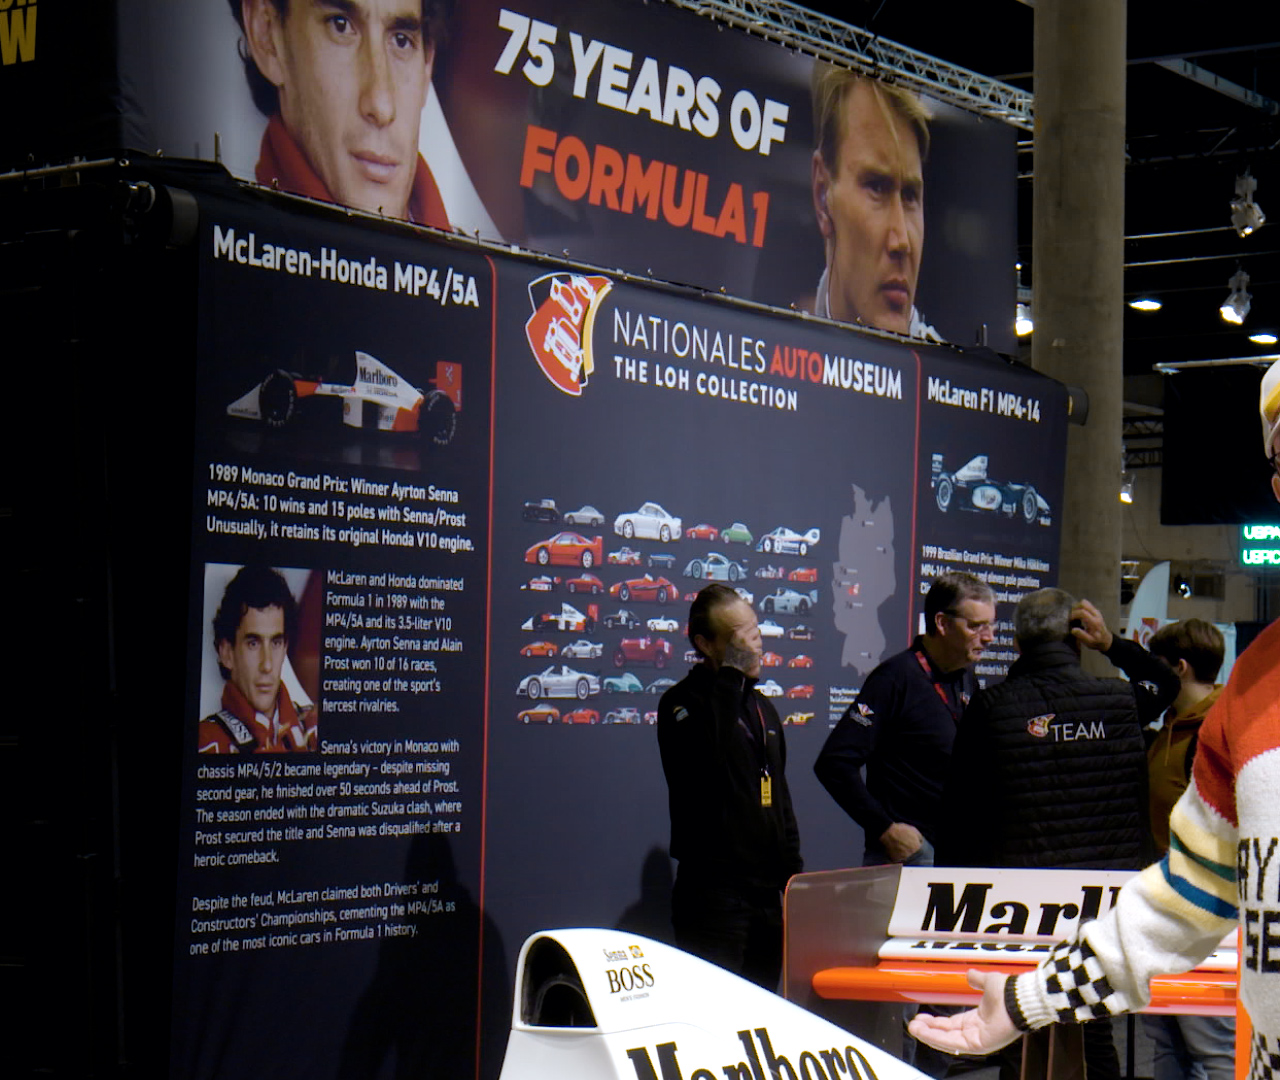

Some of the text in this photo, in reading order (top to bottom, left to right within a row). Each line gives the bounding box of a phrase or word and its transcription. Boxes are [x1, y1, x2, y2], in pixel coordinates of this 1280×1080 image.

[494, 8, 790, 156] 75 YEARS OF
[213, 224, 480, 308] McLaren-Honda MP4/5A
[613, 307, 903, 401] NATIONALES AUTOMUSEUM
[614, 355, 798, 411] THE LOH COLLECTION
[927, 376, 1041, 423] McLaren F1 MP4-14
[209, 464, 238, 483] 1989
[241, 467, 284, 487] Monaco
[287, 471, 320, 490] Grand
[350, 476, 389, 496] Winner
[391, 480, 426, 503] Ayrton
[428, 483, 458, 502] Senna
[263, 494, 277, 512] 10
[279, 496, 306, 514] wins
[308, 498, 328, 516] and
[332, 500, 344, 517] 15
[346, 502, 375, 523] poles
[377, 504, 400, 522] with
[403, 507, 466, 531] Senna/Prost
[270, 520, 278, 537] it
[281, 521, 319, 540] retains
[322, 524, 336, 541] its
[338, 525, 379, 548] original
[381, 528, 414, 547] Honda
[416, 531, 437, 549] V10
[327, 570, 464, 591] McLaren and Honda dominated
[326, 592, 365, 607] Formula
[375, 594, 384, 608] in
[387, 594, 408, 609] 1989
[409, 595, 428, 610] with
[430, 596, 445, 610] the
[326, 613, 452, 631] MP4/5A and its 3.5-liter V10
[360, 636, 390, 652] Ayrton
[392, 636, 420, 650] Senna
[422, 637, 439, 651] and
[440, 638, 462, 651] Alain
[324, 656, 350, 670] Prost
[351, 660, 371, 670] won
[374, 657, 384, 671] 10
[386, 657, 396, 671] of
[398, 657, 409, 671] 16
[323, 678, 440, 695] creating one of the sport's
[1050, 720, 1106, 742] TEAM
[920, 881, 1122, 937] Marl
[605, 963, 655, 994] BOSS
